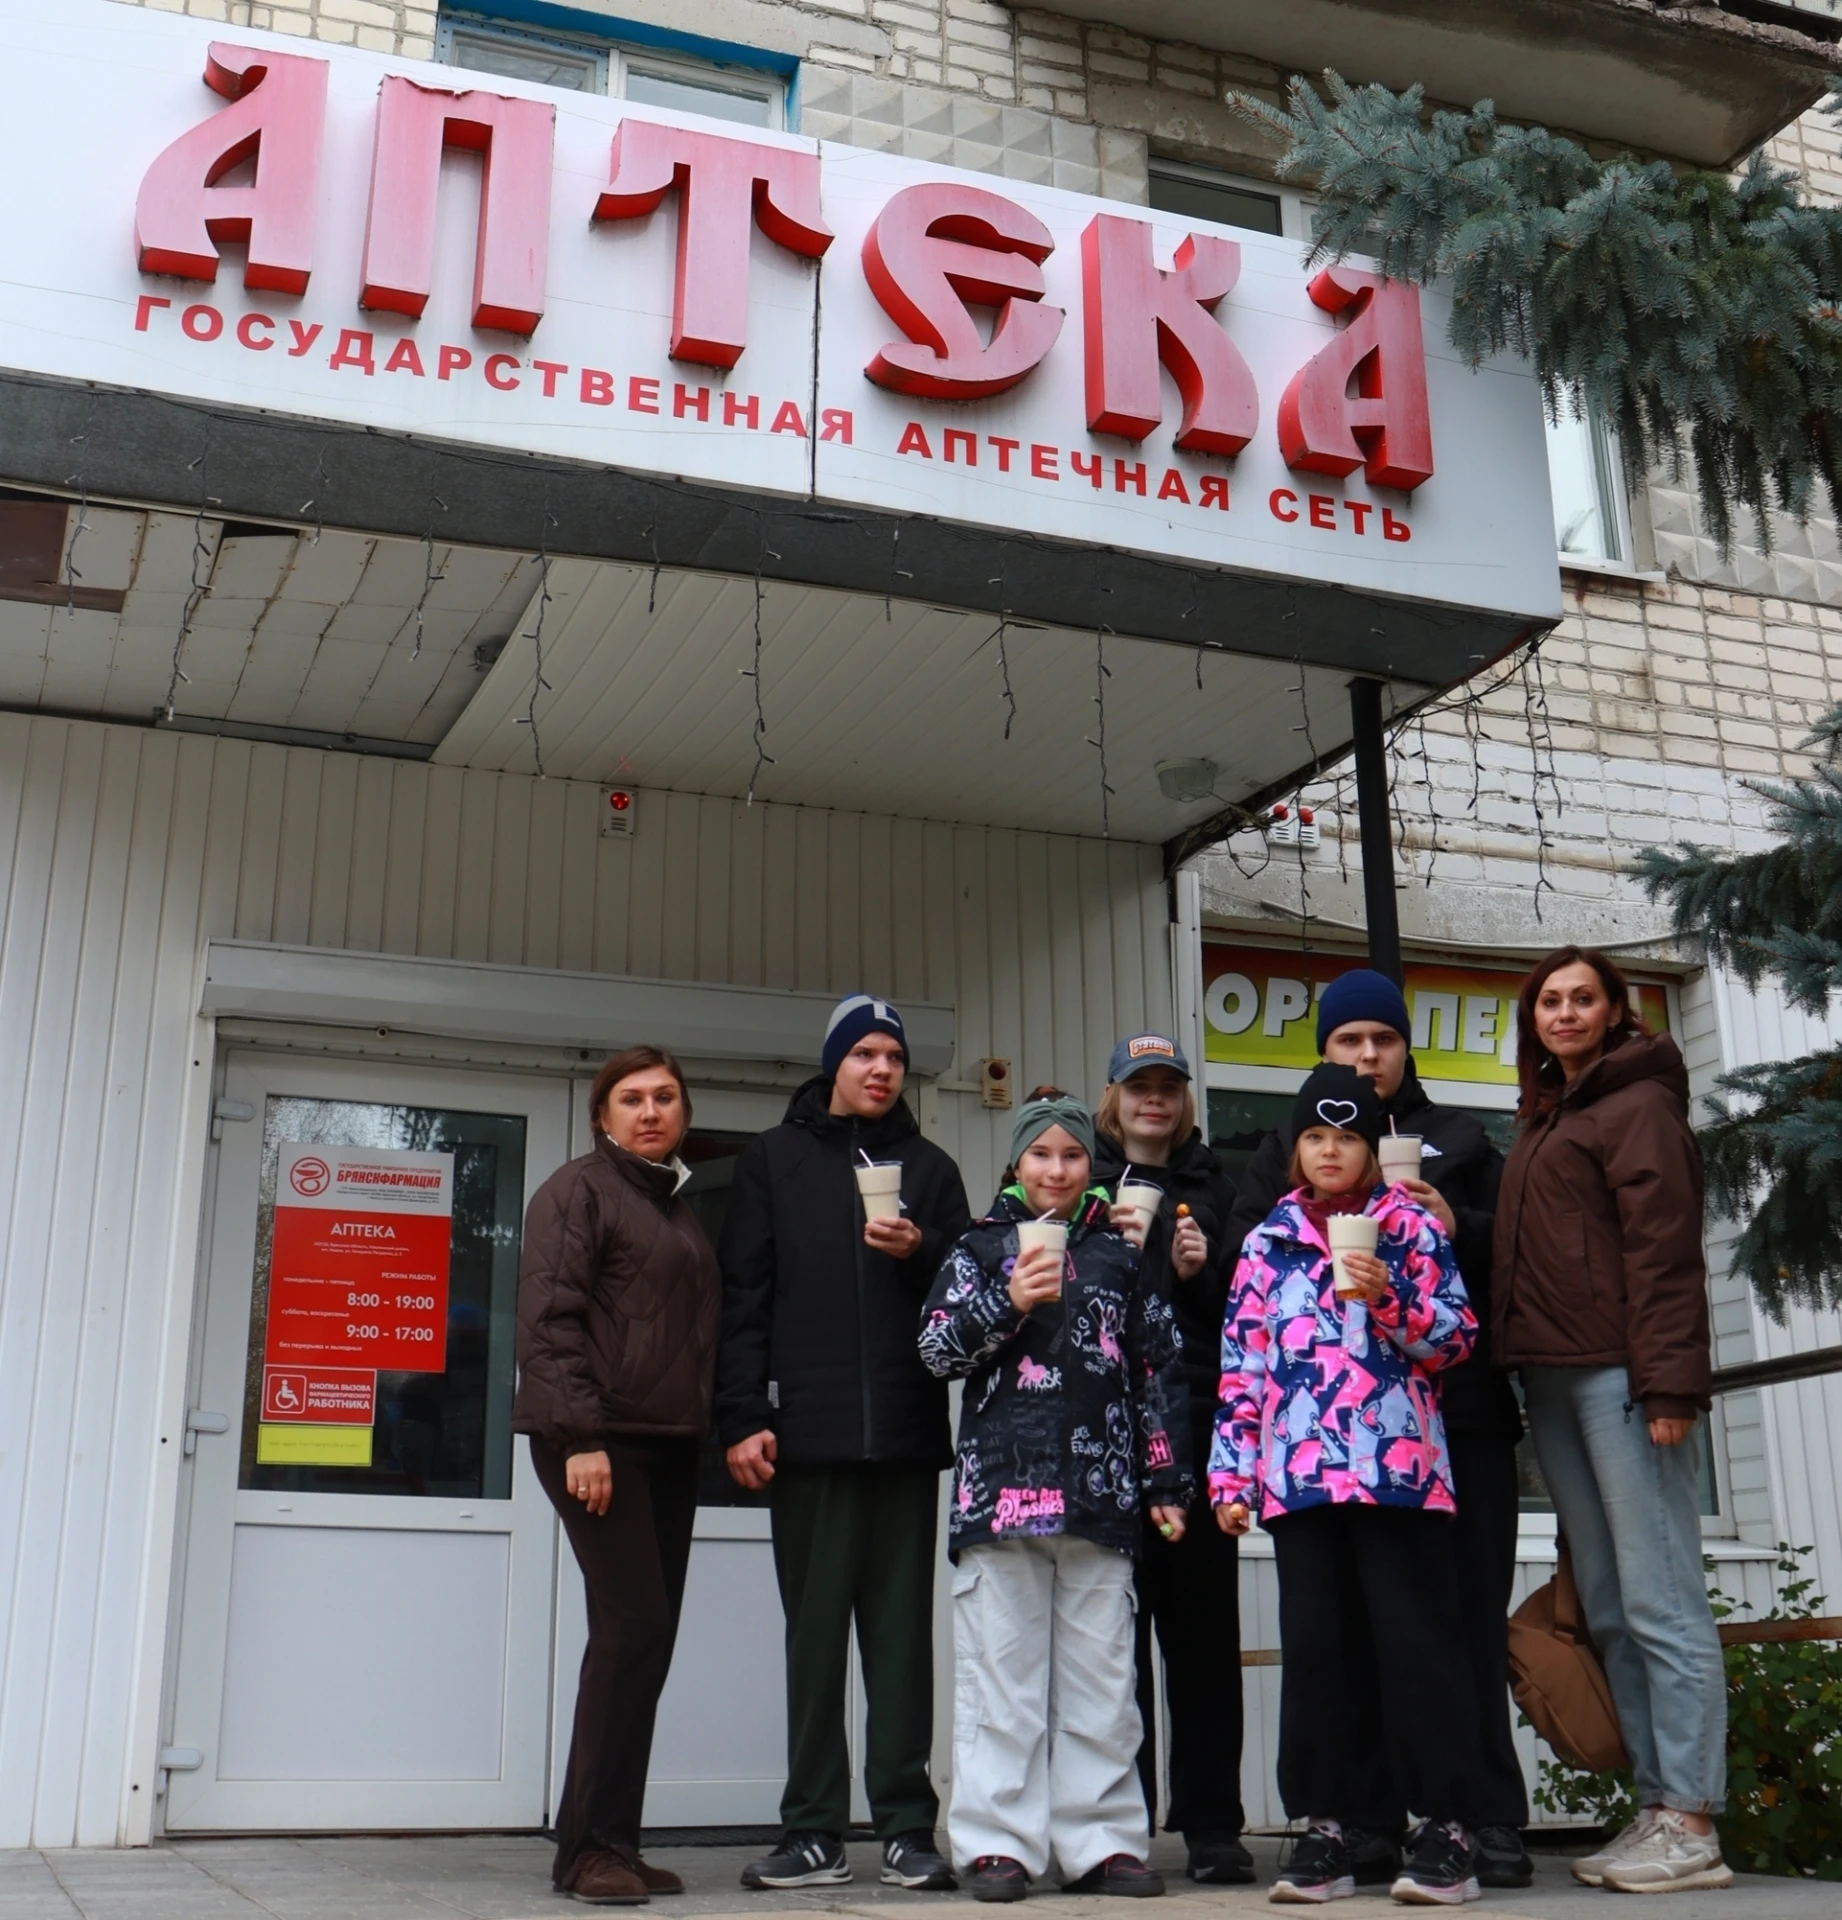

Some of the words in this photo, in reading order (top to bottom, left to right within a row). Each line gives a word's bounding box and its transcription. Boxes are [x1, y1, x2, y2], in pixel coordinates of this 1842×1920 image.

[135, 41, 1434, 490] АПТЕКА
[134, 295, 853, 445] ГОСУДАРСТВЕННАЯ
[896, 422, 1230, 511] АПТЕЧНАЯ
[1268, 489, 1411, 542] СЕТЬ
[336, 1170, 442, 1189] БРЯНСКФАРМАЦИЯ
[330, 1222, 396, 1239] АПТЕКА
[381, 1272, 408, 1280] РЕЖИМ
[347, 1292, 380, 1307] 8:00
[395, 1295, 435, 1310] 19:00
[346, 1324, 379, 1339] 9:00
[394, 1327, 434, 1342] 17:00
[309, 1383, 339, 1391] КНОПКА
[341, 1384, 371, 1392] ВЫЗОВА
[308, 1398, 371, 1410] РАБОТНИКА
